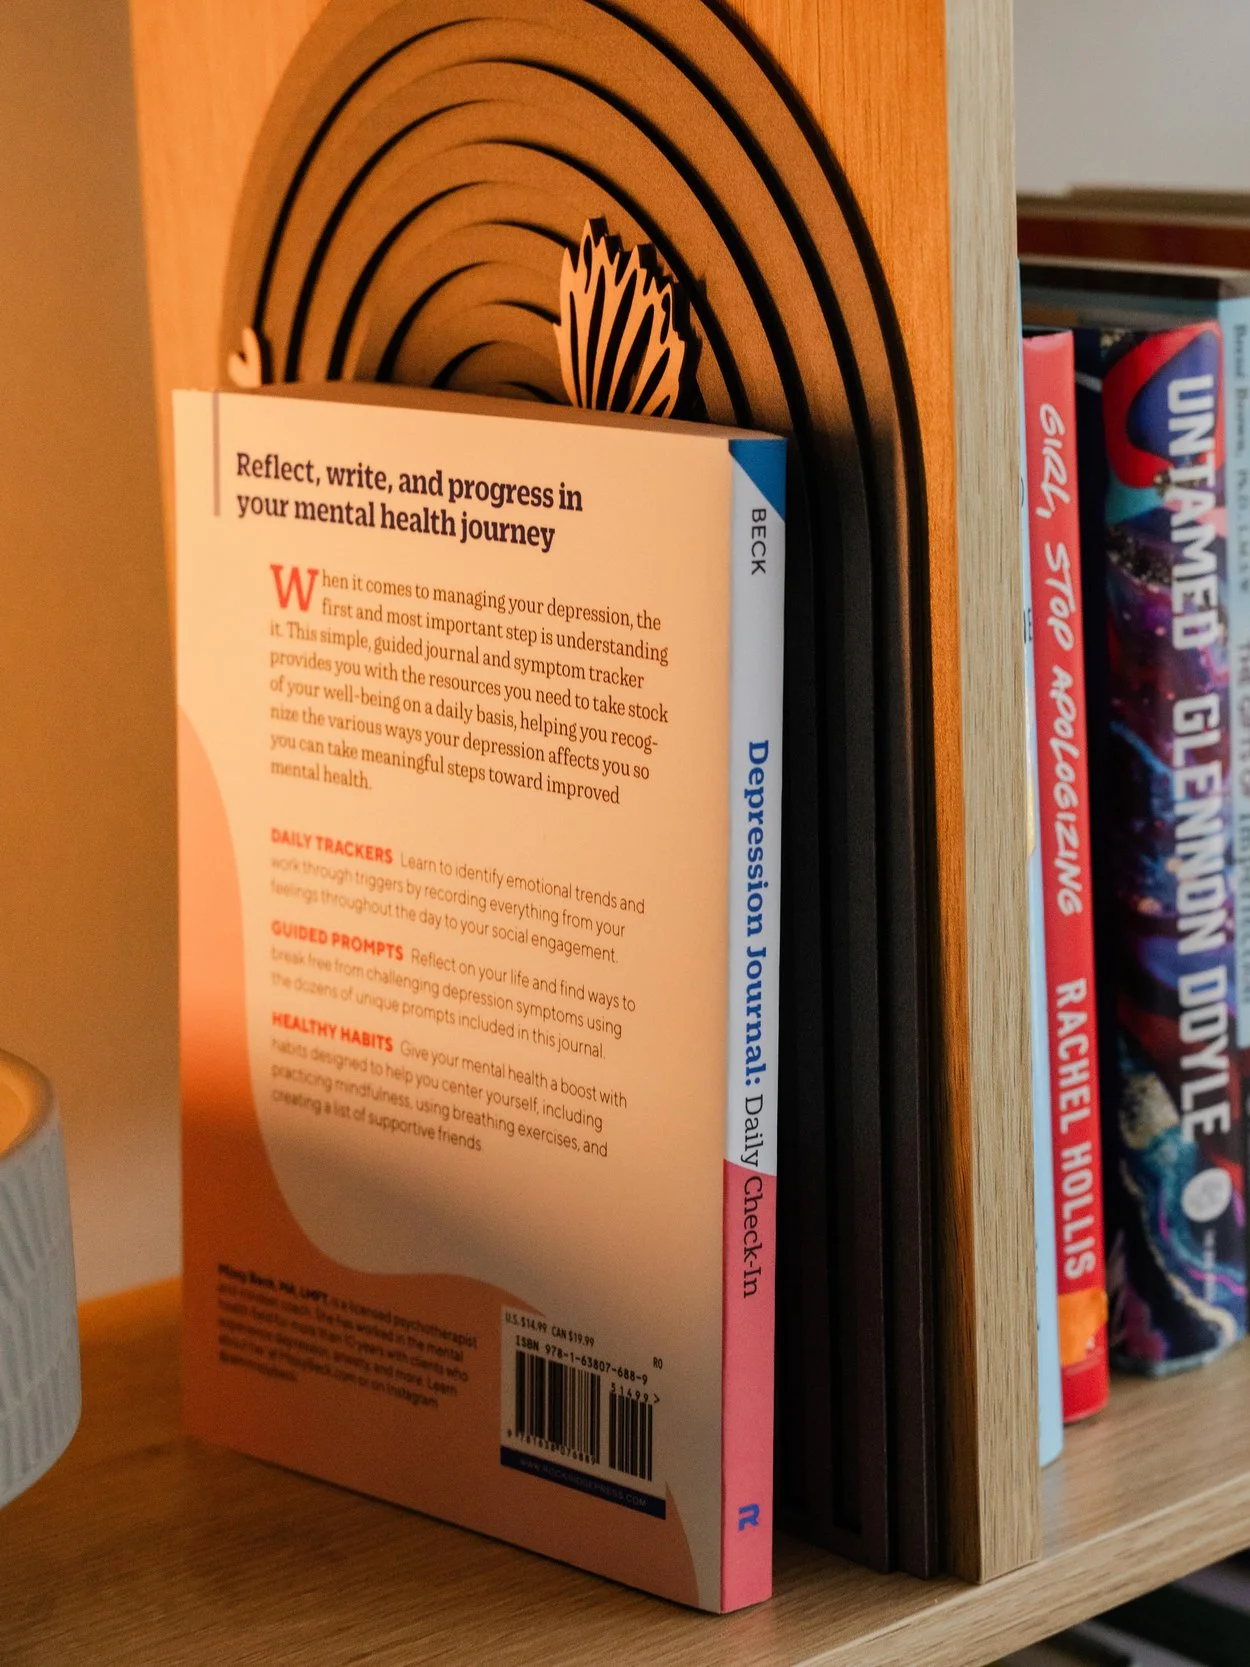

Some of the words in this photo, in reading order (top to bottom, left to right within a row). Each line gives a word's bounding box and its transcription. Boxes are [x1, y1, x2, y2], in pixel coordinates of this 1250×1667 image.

[236, 451, 320, 486] Reflect,
[325, 461, 393, 494] write,
[397, 468, 443, 497] and
[447, 477, 554, 509] progress
[558, 481, 583, 512] in
[1036, 403, 1070, 519] GIRL,
[235, 493, 289, 518] your
[293, 499, 375, 528] mental
[379, 501, 456, 537] health
[459, 510, 555, 553] journey
[750, 507, 768, 576] BECK
[1167, 376, 1219, 651] UNTAMED
[351, 573, 363, 592] it
[365, 579, 412, 598] comes
[414, 583, 430, 600] to
[432, 587, 506, 614] managing
[507, 596, 544, 615] your
[546, 596, 634, 630] depression,
[635, 608, 661, 631] the
[1046, 542, 1075, 651] STOP
[355, 603, 383, 622] and
[385, 610, 423, 628] most
[425, 611, 503, 639] important
[505, 625, 537, 647] step
[540, 626, 553, 646] is
[555, 630, 669, 667] understanding
[373, 634, 423, 656] guided
[423, 640, 479, 664] journal
[482, 649, 511, 669] and
[513, 656, 586, 680] symptom
[588, 665, 644, 689] tracker
[401, 697, 421, 713] on
[423, 701, 433, 716] a
[434, 697, 473, 725] daily
[475, 702, 517, 732] basis,
[519, 709, 577, 742] helping
[578, 725, 607, 744] you
[610, 730, 658, 755] recog-
[428, 673, 501, 697] resources
[503, 684, 532, 702] you
[534, 687, 572, 707] need
[573, 693, 590, 710] to
[592, 693, 625, 716] take
[627, 702, 668, 723] stock
[360, 748, 444, 775] meaningful
[446, 761, 486, 784] steps
[488, 767, 543, 791] toward
[546, 774, 620, 804] improved
[383, 723, 422, 744] ways
[423, 729, 460, 748] your
[462, 730, 545, 762] depression
[547, 745, 599, 771] affects
[601, 758, 630, 777] you
[632, 764, 650, 780] so
[1049, 664, 1084, 918] APOLOGIZING
[742, 740, 769, 936] Depression
[1173, 695, 1227, 954] GLENNON
[314, 834, 393, 865] TRACKERS
[399, 851, 437, 872] Learn
[438, 858, 453, 876] to
[454, 862, 504, 890] identify
[505, 874, 572, 899] emotional
[574, 885, 618, 909] trends
[619, 896, 645, 915] and
[423, 884, 487, 914] recording
[488, 897, 559, 928] everything
[561, 907, 593, 931] from
[594, 919, 626, 937] your
[459, 919, 490, 936] your
[491, 924, 528, 944] social
[530, 932, 618, 964] engagement.
[330, 930, 404, 961] PROMPTS
[410, 946, 456, 973] Reflect
[457, 961, 476, 976] on
[477, 965, 508, 983] your
[509, 968, 530, 989] life
[531, 976, 557, 994] and
[559, 978, 585, 1001] find
[586, 989, 620, 1011] ways
[621, 994, 636, 1013] to
[441, 982, 514, 1011] depression
[515, 999, 584, 1028] symptoms
[586, 1016, 622, 1040] using
[457, 1014, 515, 1038] included
[516, 1023, 530, 1041] in
[531, 1027, 556, 1048] this
[556, 1036, 606, 1060] journal.
[743, 946, 769, 1086] Journal:
[339, 1026, 393, 1053] HABITS
[398, 1038, 429, 1062] Give
[430, 1050, 460, 1068] your
[460, 1056, 506, 1079] mental
[507, 1063, 548, 1089] health
[549, 1078, 558, 1092] a
[559, 1076, 597, 1102] boost
[598, 1090, 627, 1109] with
[1056, 981, 1090, 1131] RACHEL
[1180, 973, 1231, 1142] DOYLE
[440, 1078, 483, 1099] center
[484, 1089, 539, 1116] yourself,
[541, 1103, 603, 1134] including
[451, 1103, 515, 1138] breathing
[516, 1122, 580, 1152] exercises,
[582, 1139, 608, 1158] and
[741, 1096, 764, 1167] Daily
[742, 1177, 763, 1299] Check-In
[1061, 1143, 1096, 1279] HOLLIS
[515, 1334, 540, 1352] ISBN
[545, 1343, 649, 1386] 978-1-63807-688-9
[520, 1316, 548, 1334] $14.99
[552, 1325, 567, 1340] CAN
[569, 1331, 595, 1348] $19.99
